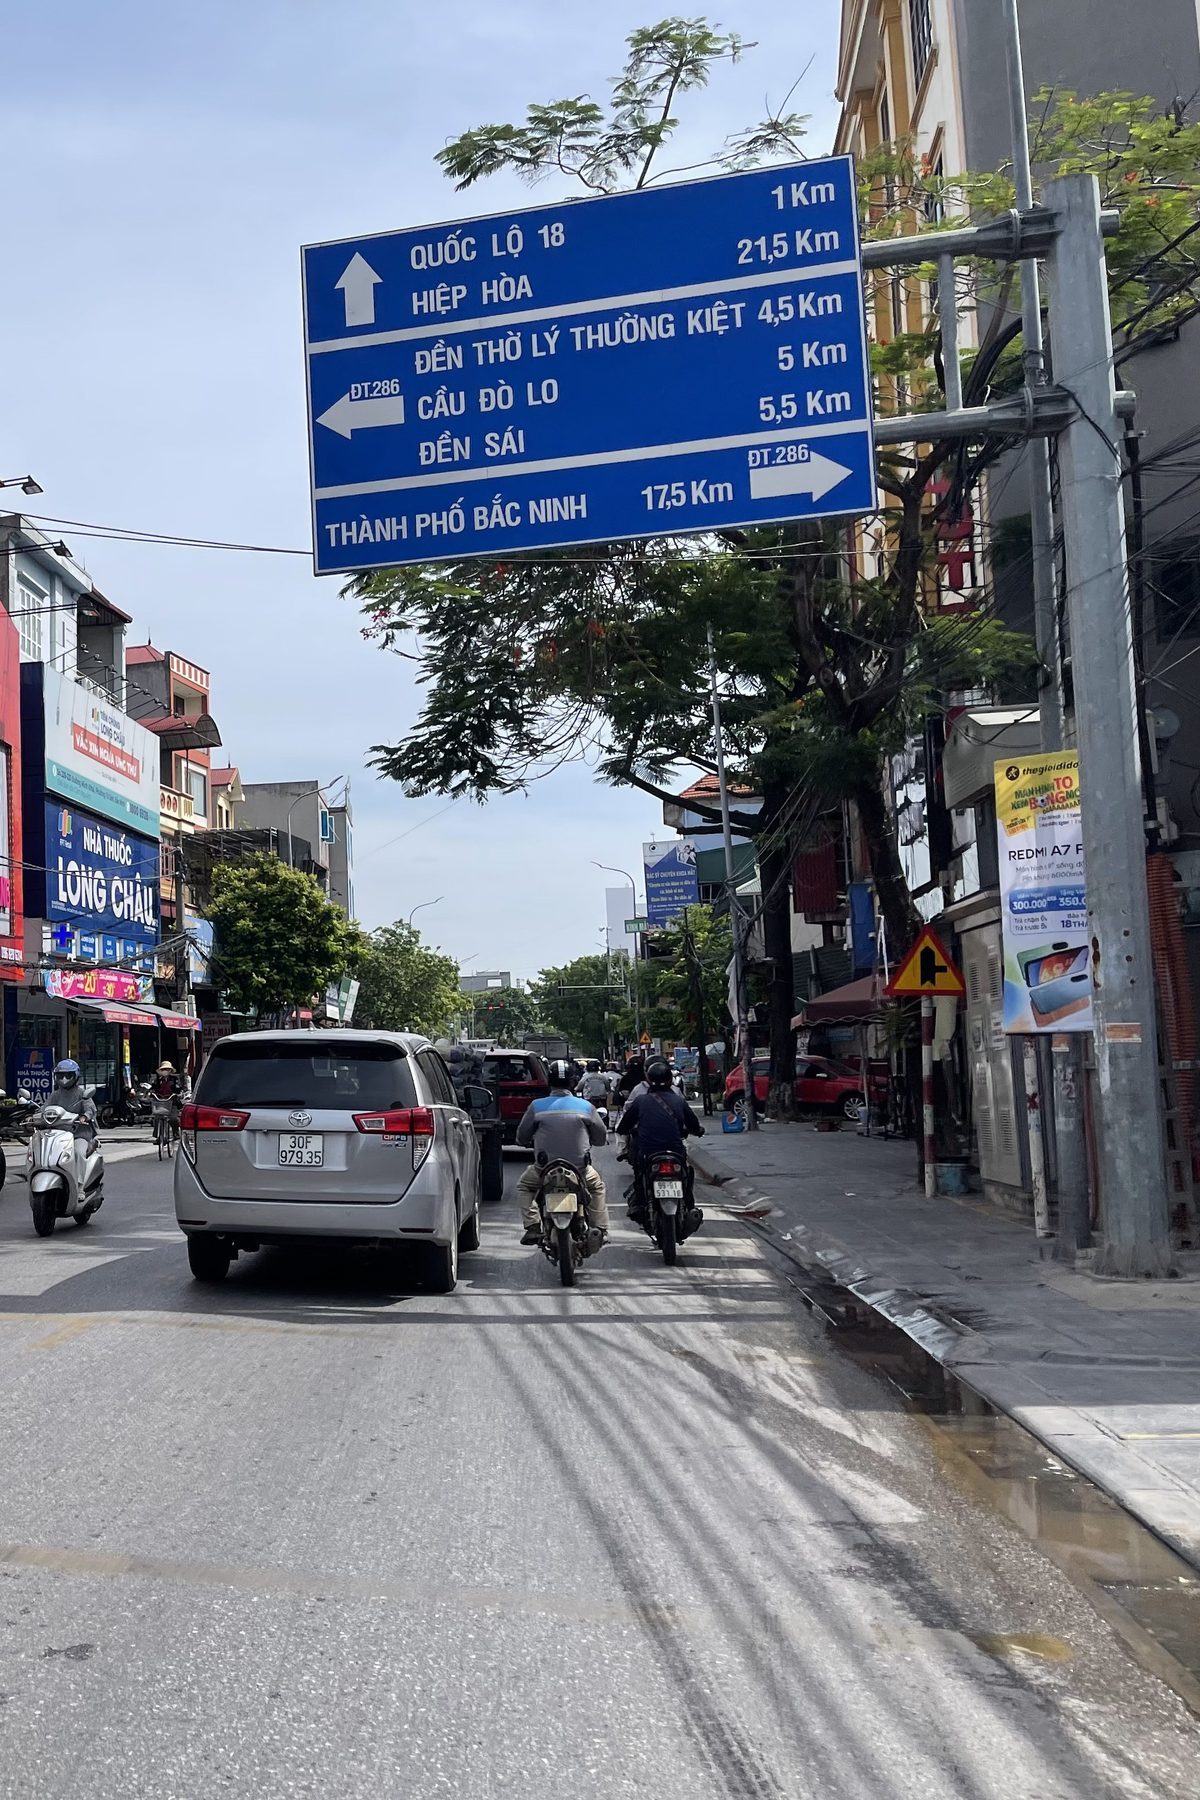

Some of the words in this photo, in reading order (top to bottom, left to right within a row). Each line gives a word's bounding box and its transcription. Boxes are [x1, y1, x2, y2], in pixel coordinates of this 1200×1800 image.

[411, 230, 477, 270] QUỐC
[493, 228, 523, 259] LỘ
[538, 222, 565, 248] 18
[738, 233, 788, 265] 21,5
[796, 228, 839, 255] Km
[413, 284, 467, 315] HIỆP
[481, 274, 533, 304] HÒA
[415, 342, 463, 375] ĐỀN
[473, 331, 522, 366] THỜ
[531, 324, 560, 358] LÝ
[570, 312, 675, 352] THƯỜNG
[688, 301, 746, 337] KIỆT
[758, 301, 794, 329] 4,5
[798, 292, 842, 317] Km
[778, 347, 793, 371] 5
[803, 341, 847, 368] Km
[350, 379, 400, 400] ĐT.286
[418, 386, 466, 421] CẦU
[479, 379, 513, 410] ĐÒ
[527, 379, 559, 404] LO
[759, 397, 798, 425] 5,5
[807, 390, 850, 417] Km
[419, 431, 470, 465] ĐỀN
[485, 429, 526, 455] SÁI
[748, 445, 809, 467] ĐT.286
[642, 483, 686, 511] 17,5
[691, 480, 733, 506] Km
[326, 513, 407, 547] THÀNH
[416, 496, 465, 539] PHỐ
[474, 493, 521, 529] BẮC
[529, 494, 587, 524] NINH
[1023, 762, 1079, 775] thegioidido
[1053, 776, 1073, 789] TO
[84, 826, 102, 856] NHÀ
[104, 834, 132, 866] THUỐC
[1009, 847, 1047, 861] REDMI
[1051, 845, 1071, 856] A7
[58, 856, 107, 913] LONG
[111, 872, 153, 926] CHÂU
[1012, 899, 1046, 910] 300.000
[17, 1078, 49, 1088] LONG
[280, 1150, 322, 1164] 979.35
[289, 1136, 312, 1150] 30F
